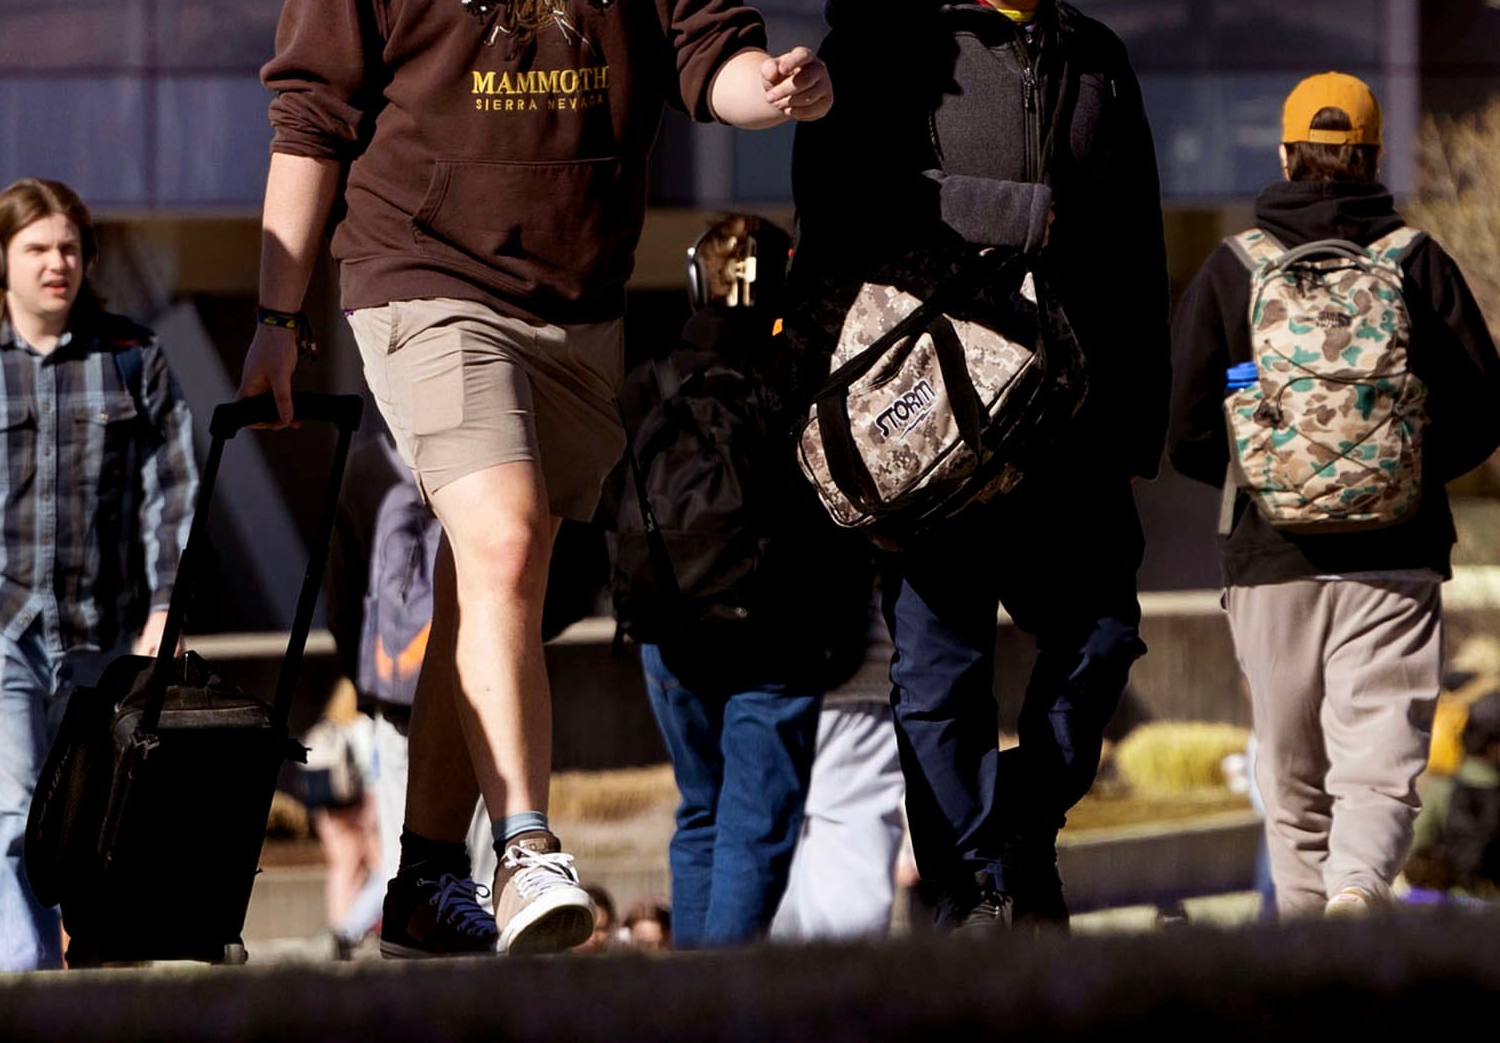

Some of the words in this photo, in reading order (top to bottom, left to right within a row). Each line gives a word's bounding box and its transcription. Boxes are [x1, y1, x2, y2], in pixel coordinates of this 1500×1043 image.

[471, 66, 609, 95] MAMMOTH
[475, 98, 538, 111] SIERRA
[875, 379, 936, 438] STORM
